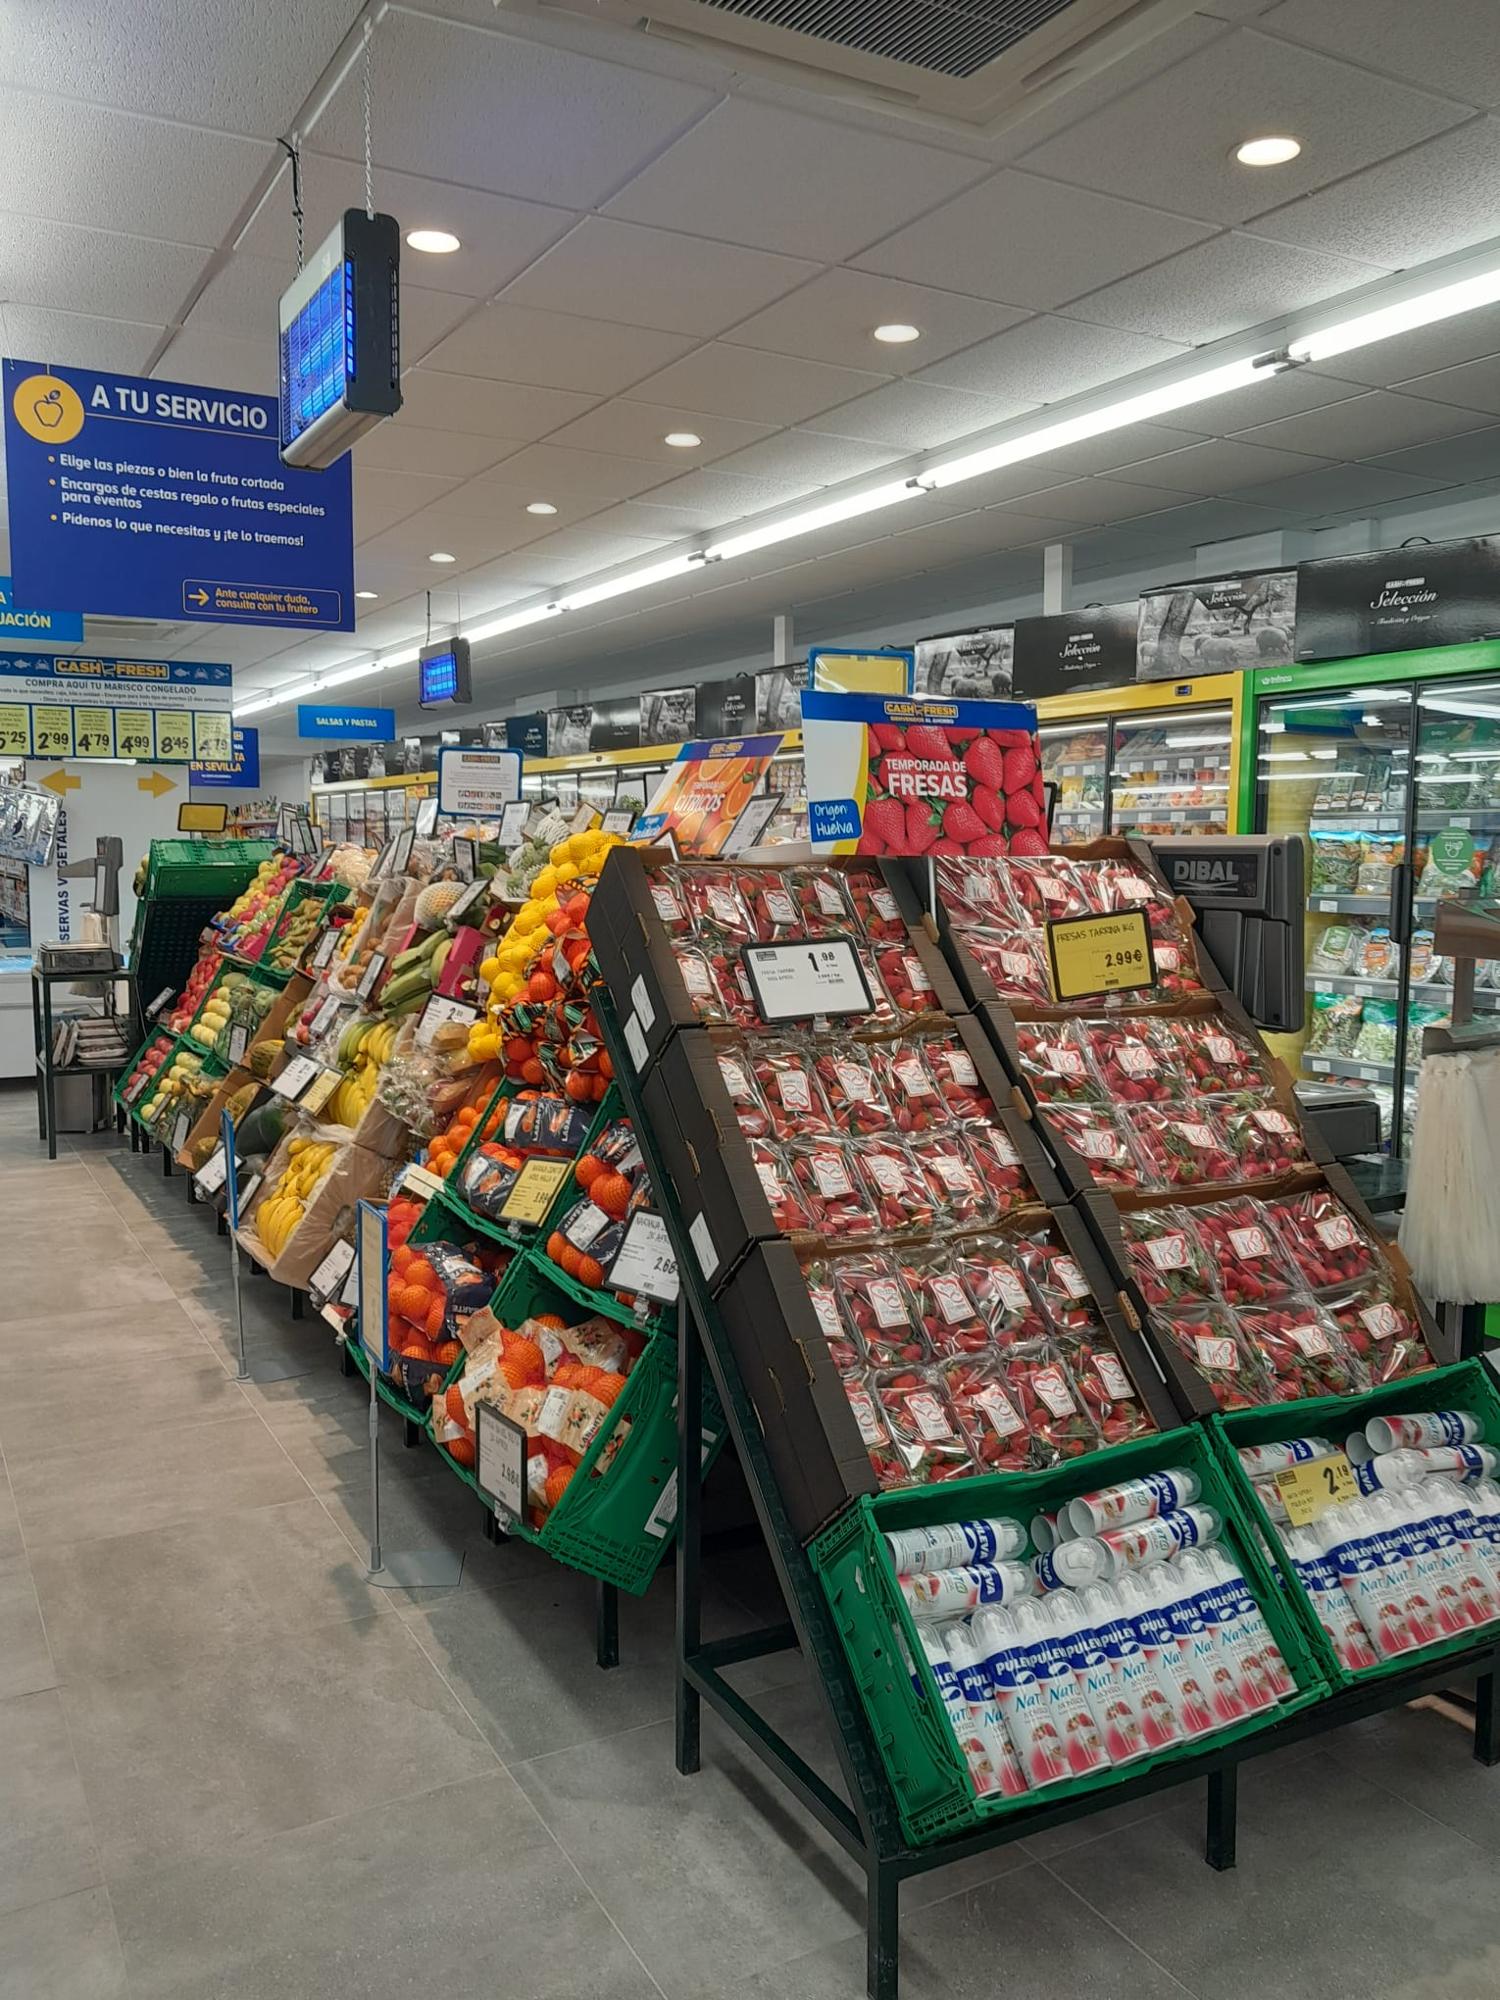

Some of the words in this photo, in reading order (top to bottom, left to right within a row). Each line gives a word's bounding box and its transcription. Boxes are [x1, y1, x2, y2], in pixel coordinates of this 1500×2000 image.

[91, 384, 110, 409] A
[115, 387, 149, 414] TU
[156, 393, 268, 430] SERVICIO
[60, 453, 92, 471] Elige
[94, 458, 113, 471] las
[116, 461, 155, 476] piezas
[158, 468, 166, 477] o
[168, 467, 194, 480] bien
[197, 470, 208, 481] la
[211, 472, 238, 486] fruta
[241, 477, 285, 491] cortada
[61, 476, 119, 496] Encargos
[121, 484, 137, 496] de
[139, 488, 178, 501] cestas
[181, 493, 219, 506] regalo
[221, 497, 229, 506] o
[231, 496, 265, 510] frutas
[267, 502, 325, 517] especiales
[61, 491, 91, 503] para
[93, 495, 142, 509] eventos
[62, 511, 112, 528] Pídenos
[115, 518, 127, 529] lo
[129, 521, 152, 533] que
[155, 524, 211, 538] necesitas
[213, 530, 221, 541] y
[223, 529, 239, 541] ¡te
[241, 530, 252, 541] lo
[255, 532, 304, 546] traemos!
[215, 588, 238, 599] Ante
[239, 590, 283, 603] cualquier
[1370, 589, 1438, 610] Selección
[215, 599, 257, 610] consulta
[257, 602, 275, 611] con
[276, 603, 286, 612] tu
[287, 603, 319, 615] frutero
[57, 660, 102, 674] CASH
[116, 663, 167, 678] FRESH
[25, 678, 65, 689] COMPRA
[90, 681, 102, 690] TU
[104, 683, 143, 692] MARISCO
[145, 684, 197, 694] CONGELADO
[886, 702, 915, 714] CASH
[924, 705, 956, 716] FRESH
[205, 762, 242, 772] SEVILLA
[885, 758, 951, 772] TEMPORADA
[952, 761, 967, 773] DE
[888, 773, 969, 798] FRESAS
[816, 821, 855, 837] Huelva
[1174, 860, 1240, 882] DIBAL
[1056, 930, 1087, 944] FRESAS
[1104, 949, 1143, 968] 2.99€
